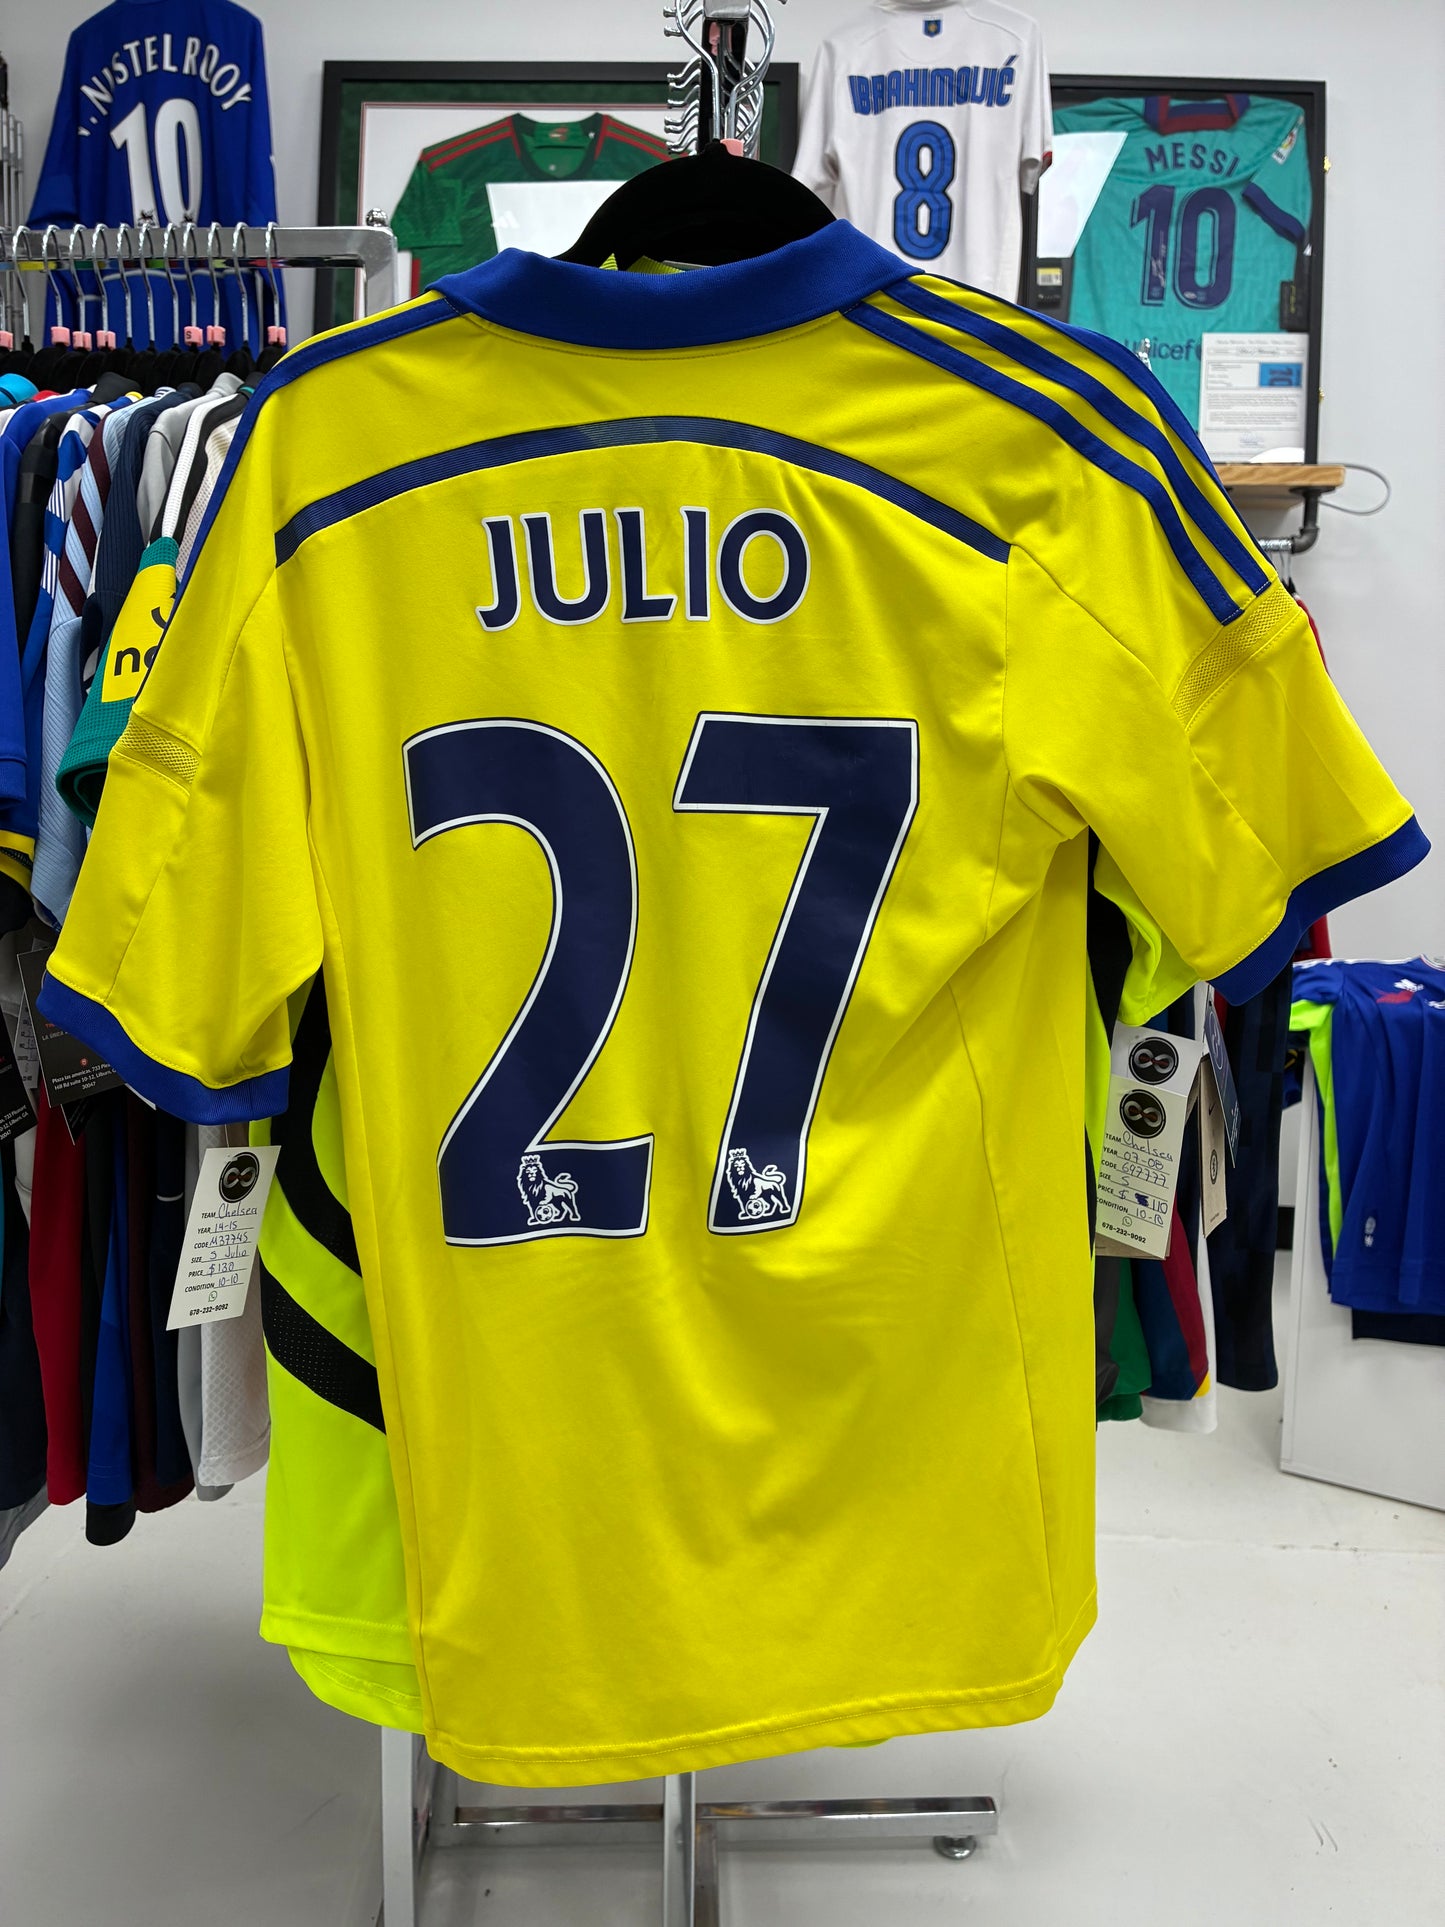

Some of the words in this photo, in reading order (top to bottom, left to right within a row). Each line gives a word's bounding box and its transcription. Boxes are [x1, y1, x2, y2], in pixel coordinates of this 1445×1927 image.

[110, 98, 203, 229] 10
[1144, 143, 1240, 177] MESSI
[894, 120, 956, 260] 8
[1130, 184, 1237, 310] 10
[1124, 336, 1195, 361] uicef
[475, 506, 810, 632] JULIO
[402, 711, 920, 1247] 27
[82, 1081, 96, 1089] 30047
[1103, 1146, 1118, 1156] YEAR
[1123, 1151, 1164, 1171] 07-08
[1105, 1133, 1121, 1143] TEAM
[1122, 1130, 1173, 1162] Chelsea
[1099, 1172, 1111, 1181] SIZE
[1121, 1175, 1130, 1187] S
[1101, 1159, 1117, 1170] CODE
[1121, 1161, 1167, 1187] 697777
[201, 1211, 216, 1219] TEAM
[218, 1200, 257, 1220] Chelsea
[1097, 1184, 1114, 1195] PRICE
[1118, 1189, 1129, 1200] $
[1152, 1199, 1168, 1215] 110
[197, 1226, 211, 1234] YEAR
[214, 1220, 237, 1233] 14-15
[1101, 1221, 1146, 1244] 678-232-9092
[191, 1256, 203, 1264] SIZE
[224, 1245, 247, 1259] Julio
[194, 1241, 209, 1250] CODE
[184, 1282, 215, 1293] CONDITION
[218, 1273, 238, 1288] 10-10
[188, 1269, 203, 1278] PRICE
[189, 1303, 228, 1317] 678-232-9092
